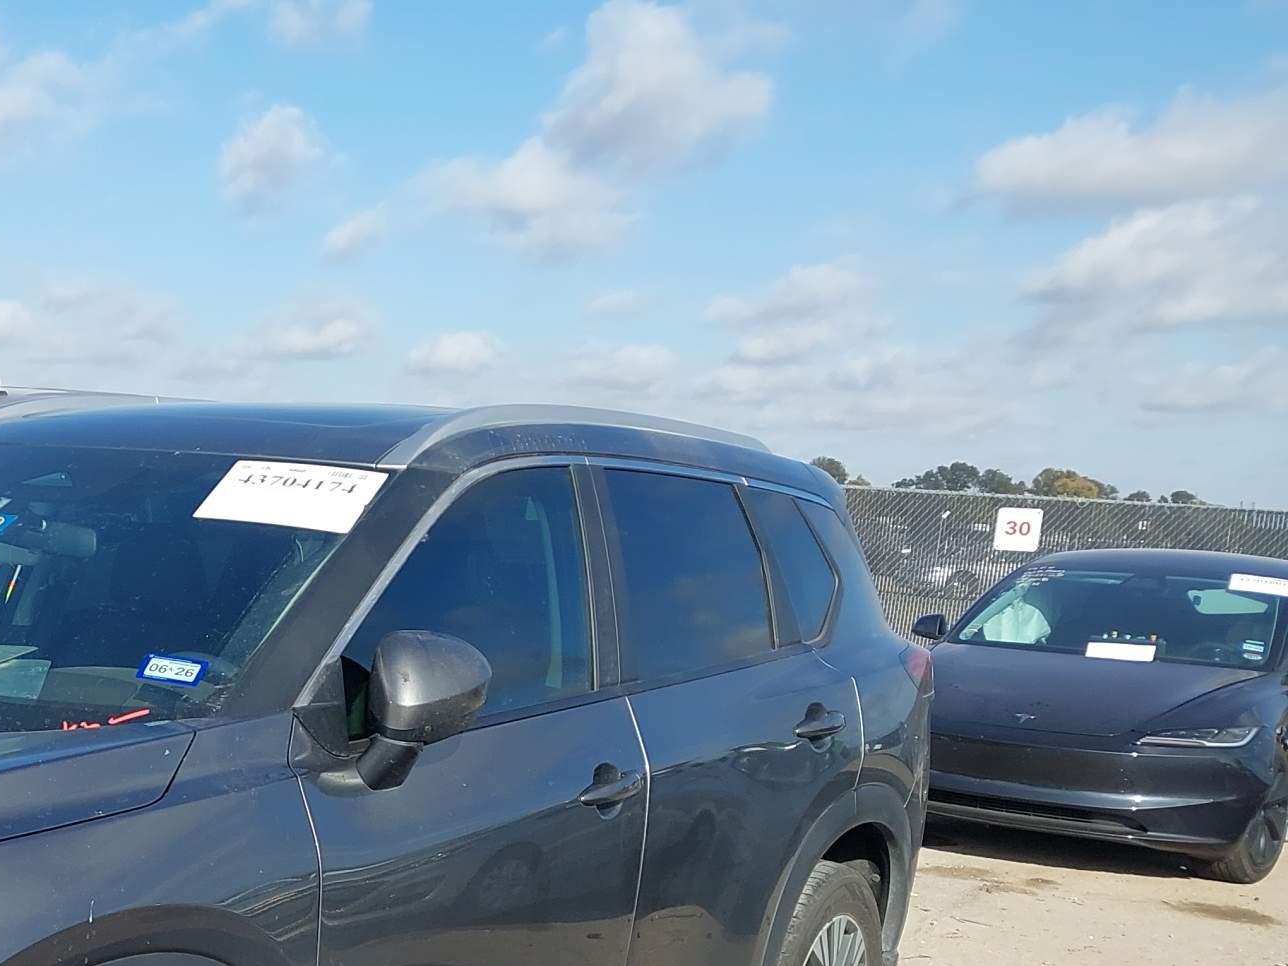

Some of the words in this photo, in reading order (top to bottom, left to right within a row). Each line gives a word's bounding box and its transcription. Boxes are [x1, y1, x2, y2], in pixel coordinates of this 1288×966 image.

[238, 474, 358, 494] 43704174
[1004, 521, 1031, 536] 30
[148, 663, 168, 674] 06
[174, 667, 195, 678] 26
